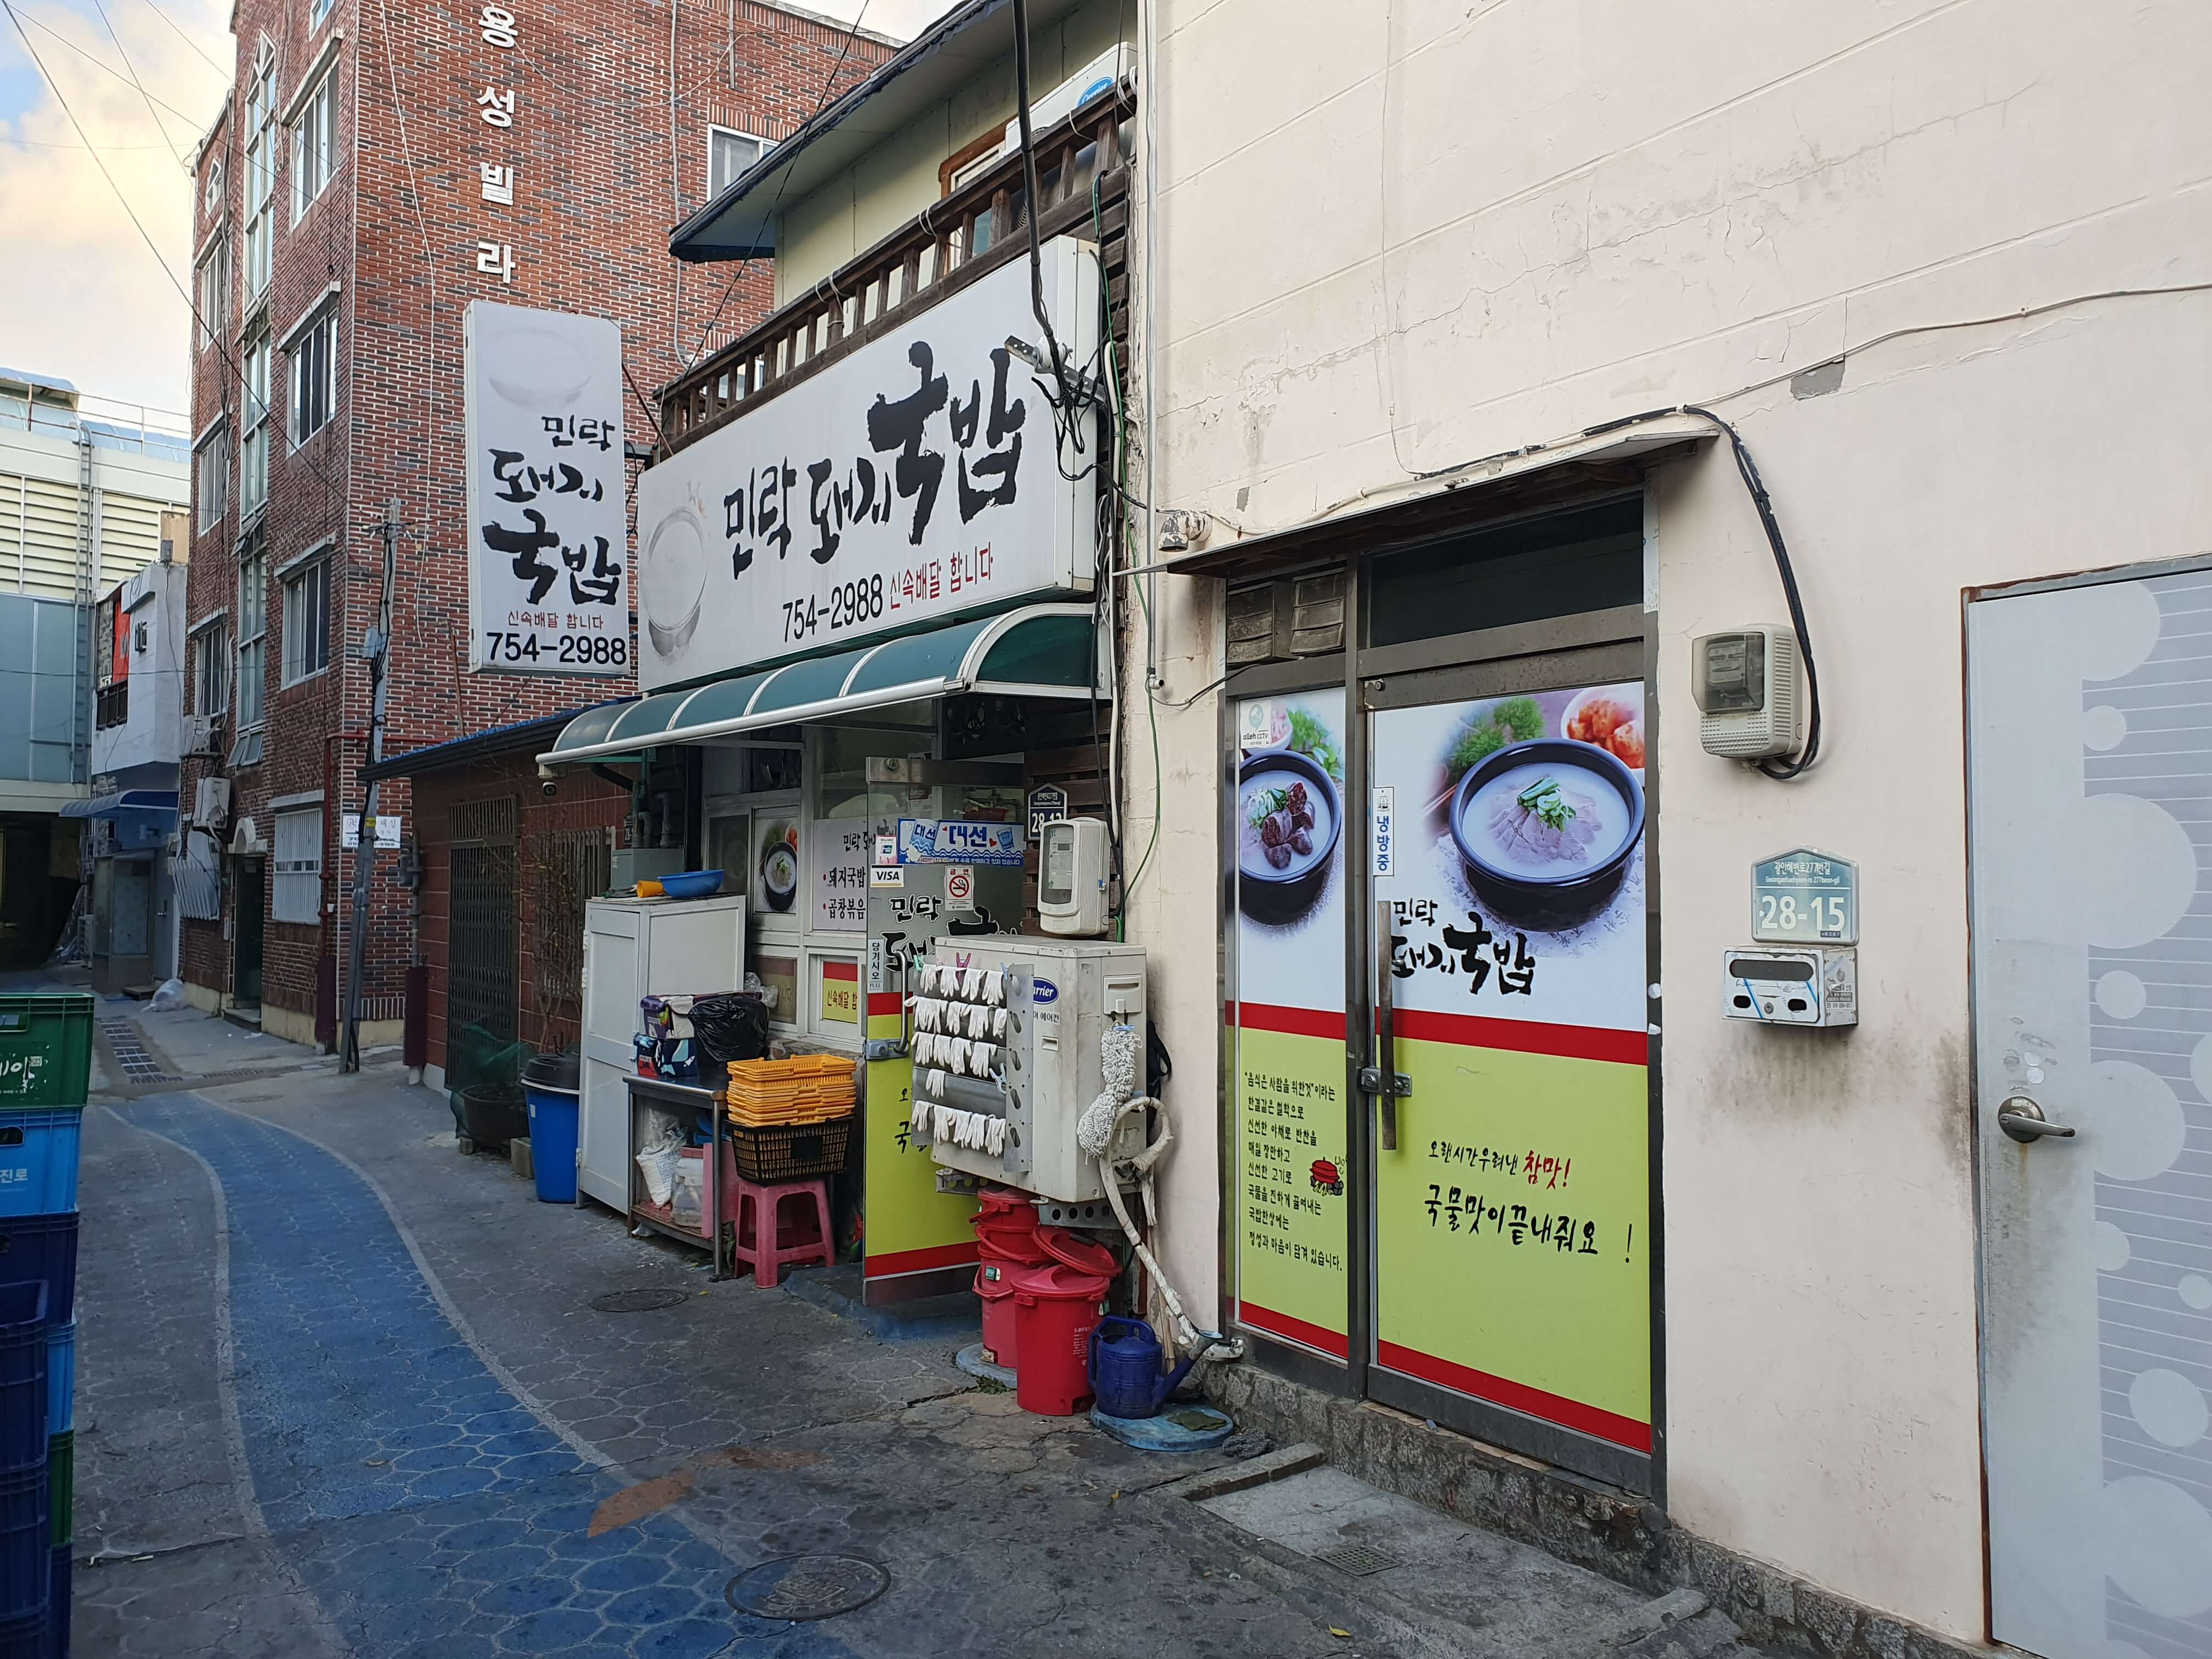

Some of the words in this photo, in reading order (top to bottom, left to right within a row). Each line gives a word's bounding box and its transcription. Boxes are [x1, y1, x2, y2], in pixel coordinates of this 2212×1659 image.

[541, 414, 616, 452] 민락
[488, 448, 603, 503] 돼지
[724, 456, 797, 580] 민락
[482, 508, 622, 605] 국밥
[783, 573, 884, 643] 754-2988
[889, 561, 943, 610] 신속배달
[950, 541, 994, 594] 합니다
[507, 610, 558, 629] 신속배달
[566, 613, 604, 630] 합니다
[487, 632, 627, 665] 754-2988
[843, 832, 860, 852] 민락
[915, 824, 936, 839] 대선
[949, 825, 988, 848] 대선
[1376, 815, 1389, 871] 냉방중
[829, 866, 866, 888] 돼지국밥
[876, 871, 900, 881] VISA
[1774, 861, 1831, 875] 광안해변로277번길
[828, 898, 866, 919] 곱창볶음
[890, 894, 943, 923] 민락
[1393, 898, 1438, 926] 민락
[1762, 895, 1845, 930] 28-15
[871, 941, 880, 979] 당기시오
[827, 989, 849, 1009] 신속배달
[1041, 1012, 1059, 1023] 에어컨
[1269, 1076, 1289, 1093] 사람을
[1248, 1096, 1274, 1114] 한결같은
[1277, 1101, 1304, 1119] 철학으로
[1248, 1119, 1267, 1136] 신선한
[1296, 1128, 1317, 1146] 반찬을
[1249, 1141, 1261, 1157] 매일
[1263, 1144, 1290, 1163] 장만하고
[1248, 1161, 1268, 1180] 신선한
[1272, 1167, 1292, 1184] 고기로
[1523, 1149, 1571, 1190] 참맛!
[1248, 1184, 1268, 1202] 국물을
[1271, 1189, 1290, 1208] 진하게
[1293, 1195, 1321, 1216] 끓여내는
[1249, 1206, 1289, 1231] 국밥한상에는
[1249, 1231, 1268, 1250] 정성과
[1271, 1237, 1291, 1257] 마음이
[1294, 1244, 1308, 1262] 담겨
[1311, 1248, 1342, 1272] 있습니다.
